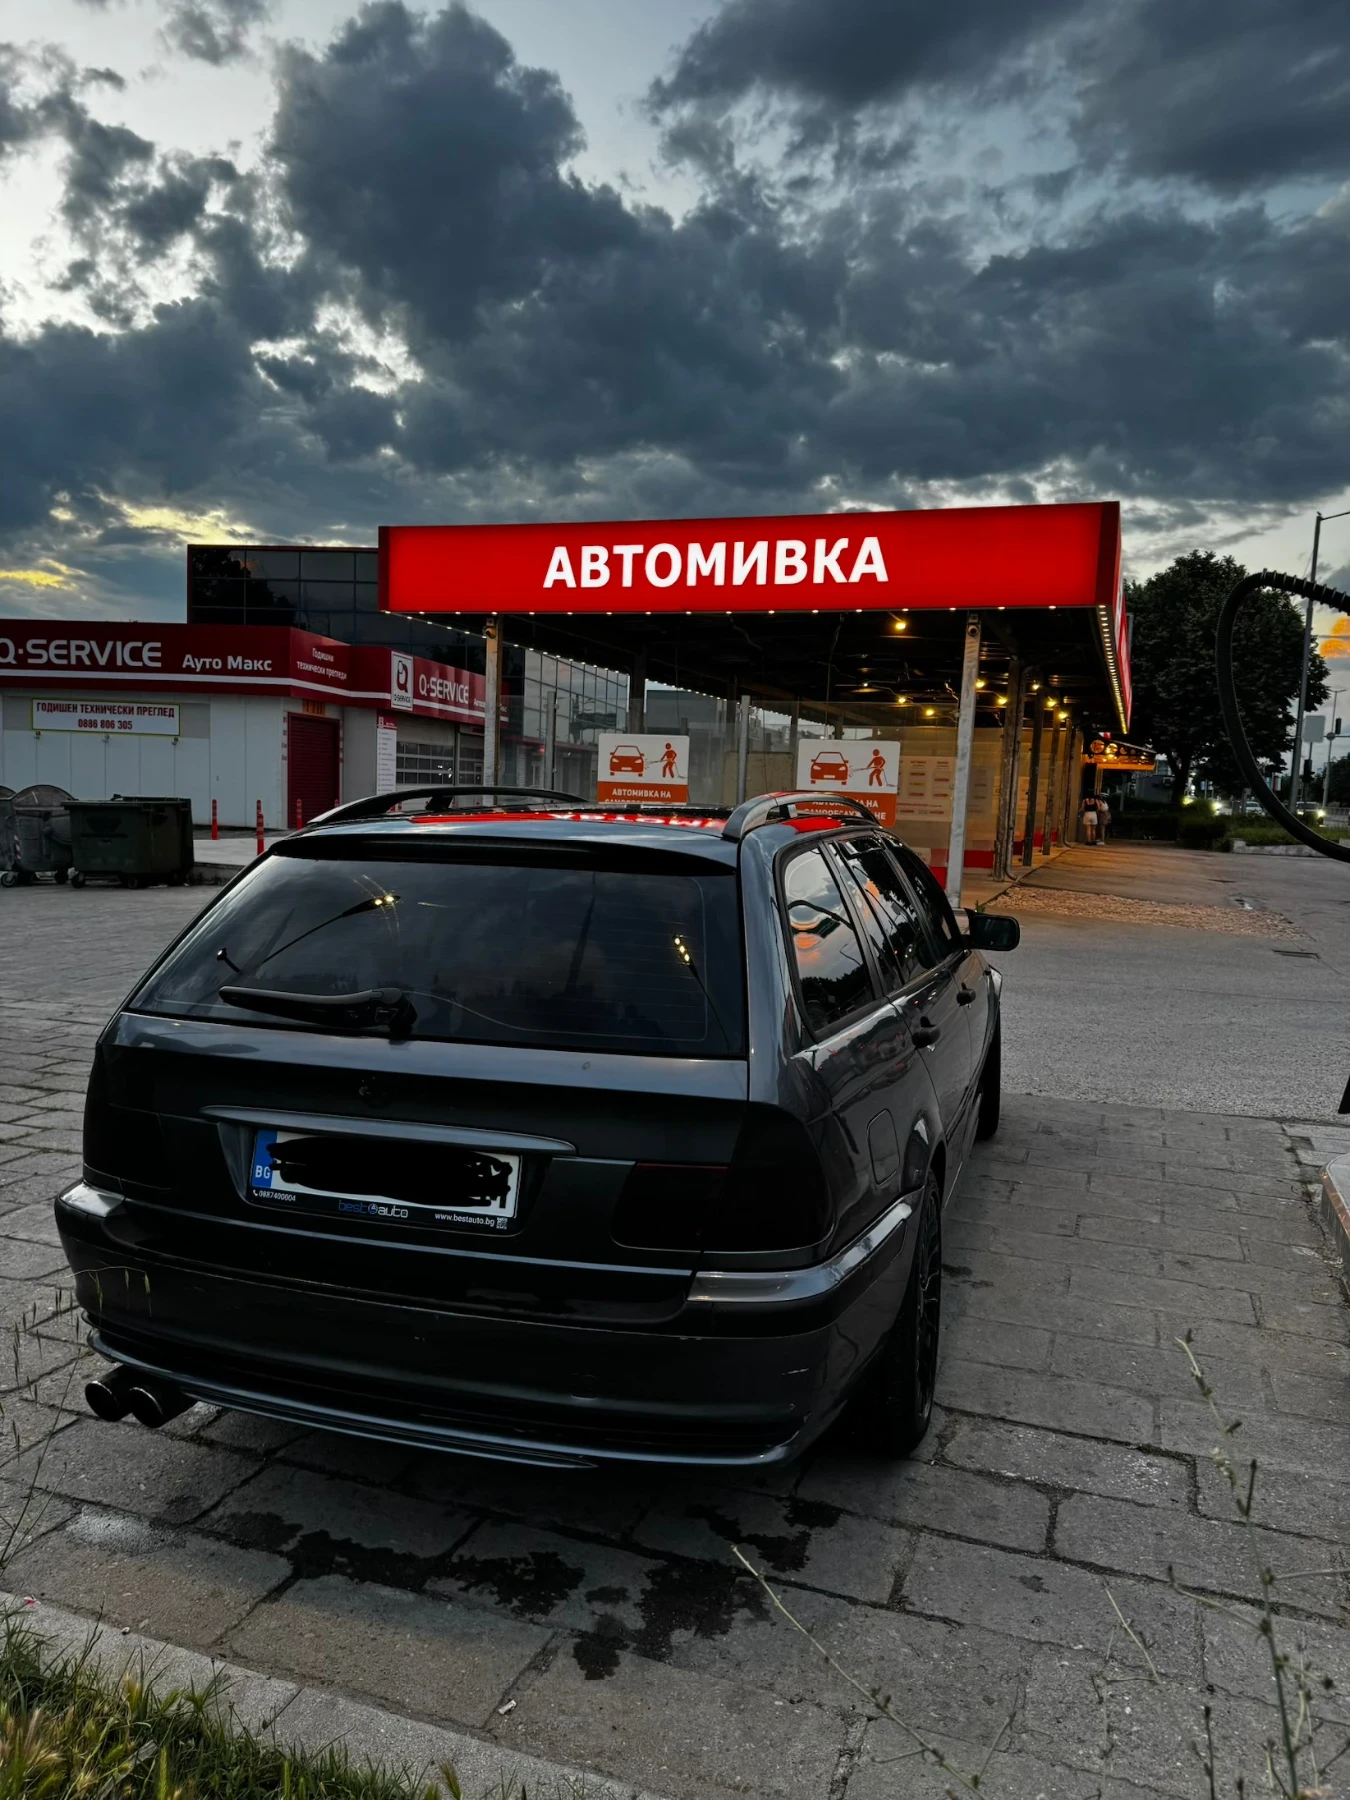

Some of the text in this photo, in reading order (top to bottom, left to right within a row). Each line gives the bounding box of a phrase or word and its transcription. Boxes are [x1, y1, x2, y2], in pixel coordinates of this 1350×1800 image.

[542, 536, 890, 589] АВТОМИВКА
[182, 654, 272, 672] Ауто Макс
[36, 702, 175, 718] ГОДИШЕН ТЕХНИЧЕСКИ ПРЕГЛЕД
[78, 719, 133, 730] 0886 806 305
[612, 788, 671, 799] АВТОМИВКА НА
[255, 1164, 271, 1179] BG
[434, 1212, 495, 1228] www.bestauto.bg
